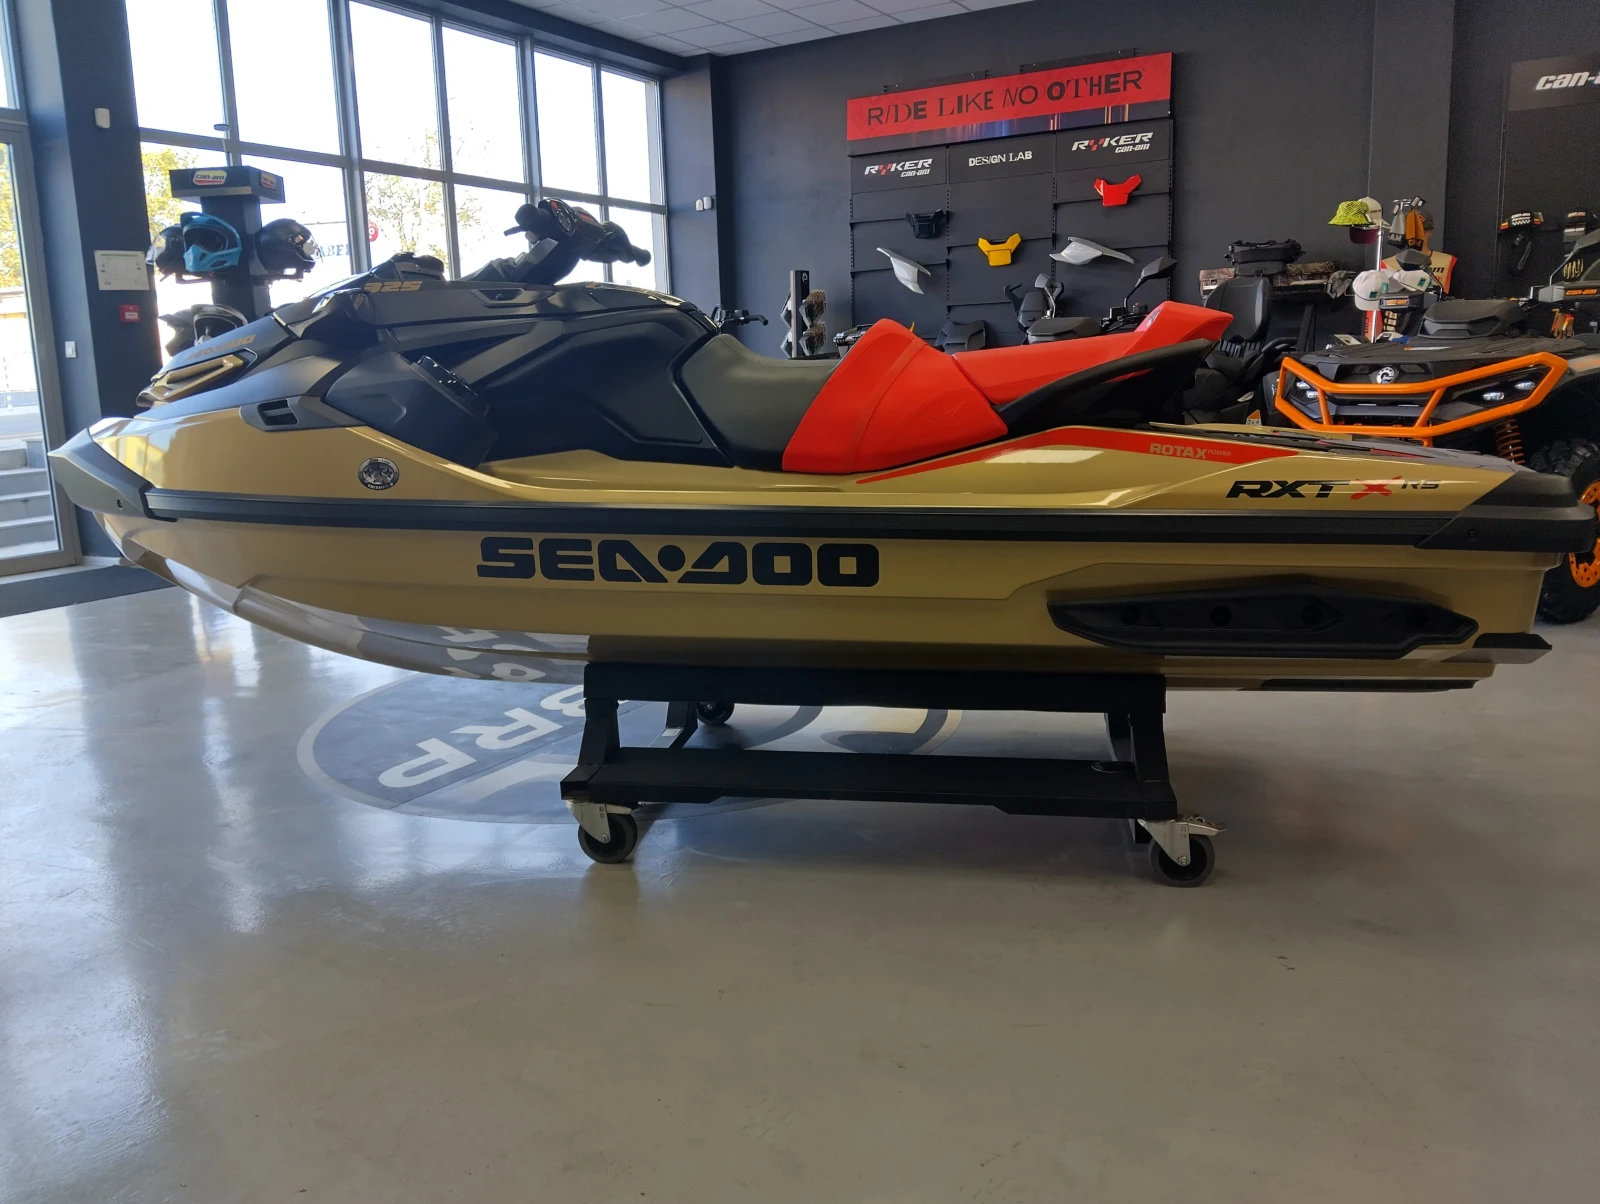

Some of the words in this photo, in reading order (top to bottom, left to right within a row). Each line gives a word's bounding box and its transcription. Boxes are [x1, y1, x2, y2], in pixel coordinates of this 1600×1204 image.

[1535, 72, 1600, 90] can-
[867, 100, 928, 126] RIDE
[937, 90, 994, 117] LIKE
[1002, 85, 1039, 108] NO
[1047, 70, 1143, 101] OTHER
[1071, 132, 1154, 151] RYKER
[1115, 143, 1151, 154] can-am
[864, 158, 933, 175] RYKER
[968, 154, 1007, 167] DESIGN
[1009, 150, 1033, 161] LAB
[900, 168, 931, 178] can-am
[364, 281, 423, 293] 325
[1149, 443, 1208, 459] ROTAX
[1225, 480, 1351, 499] RXT
[1400, 480, 1441, 490] RS
